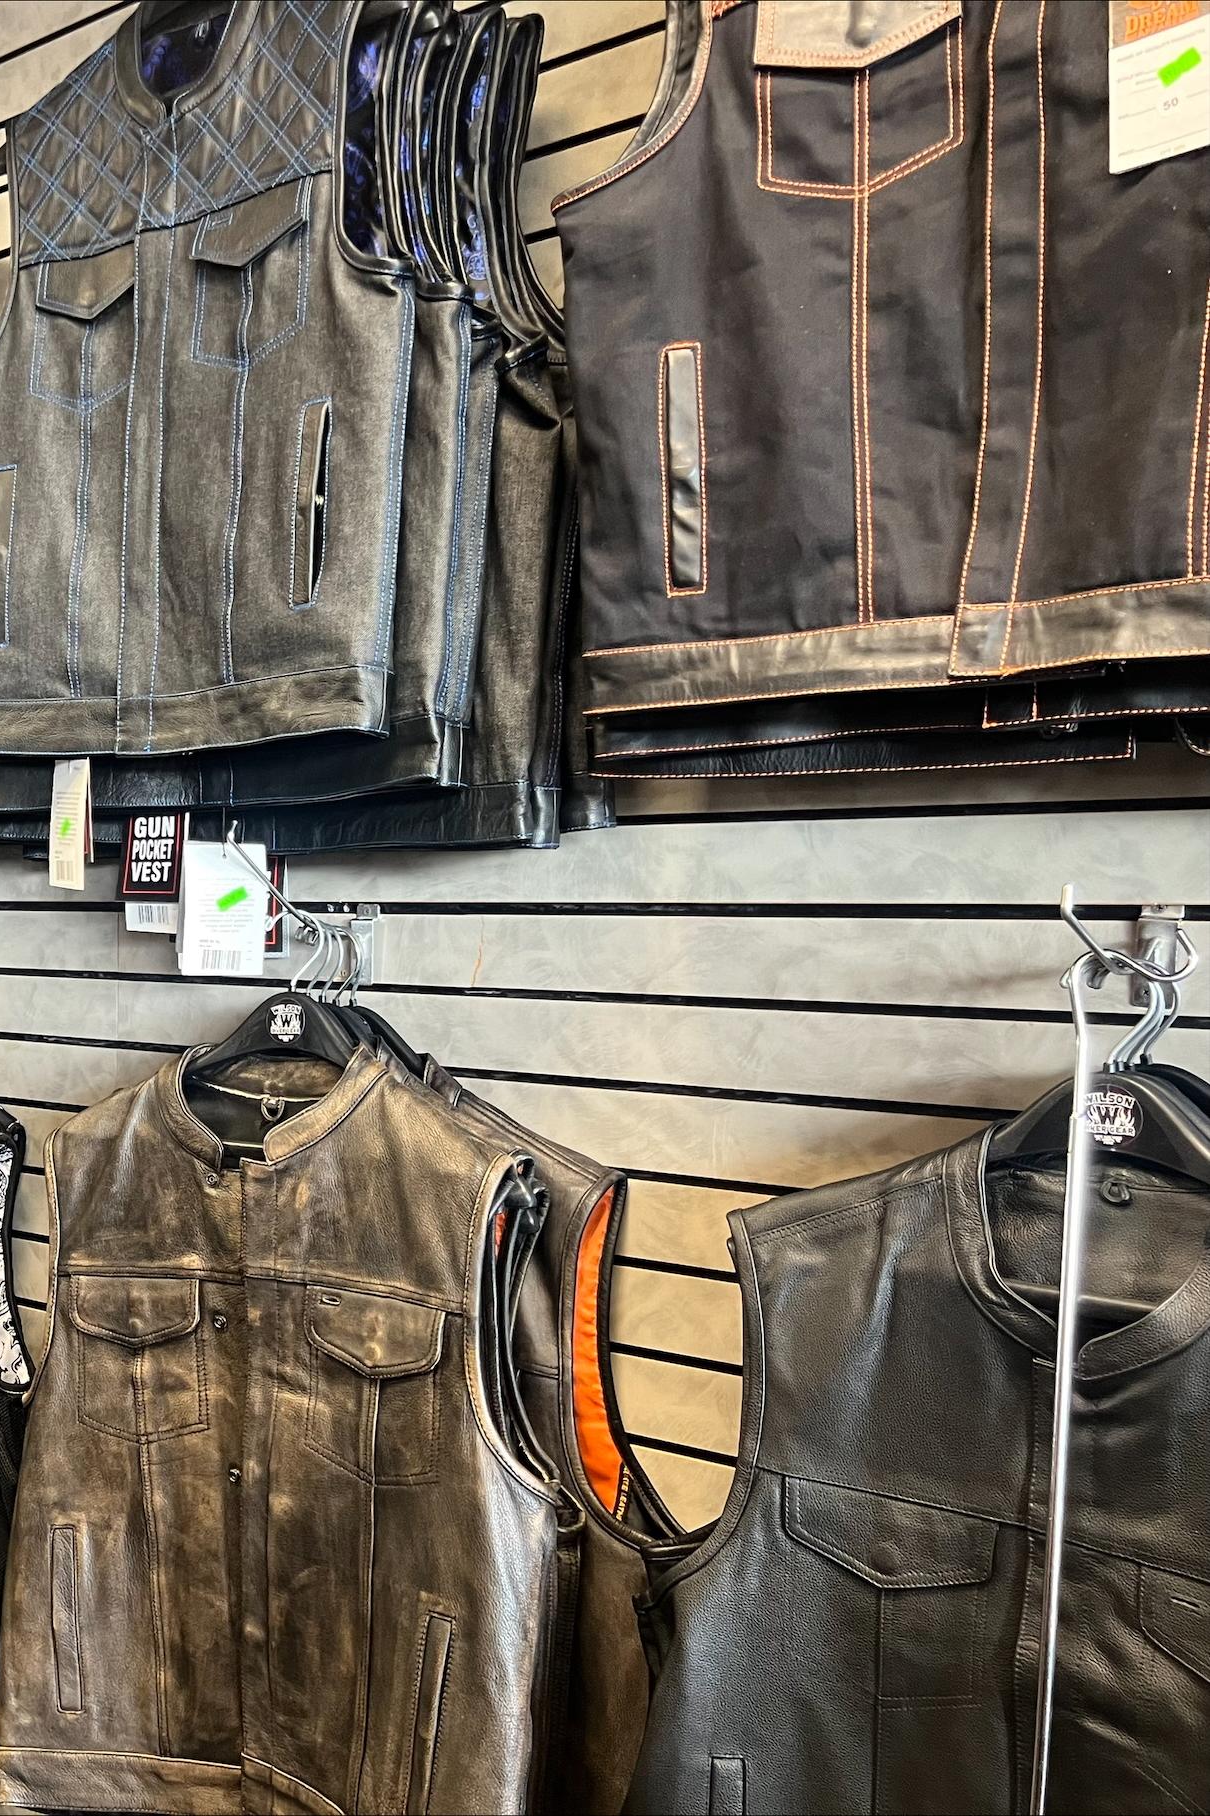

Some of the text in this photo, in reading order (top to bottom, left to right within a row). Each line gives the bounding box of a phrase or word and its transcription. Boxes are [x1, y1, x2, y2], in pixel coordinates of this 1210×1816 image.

[1163, 97, 1179, 111] 50
[134, 816, 175, 838] GUN
[132, 839, 174, 860] POCKET
[131, 862, 172, 882] VEST
[271, 1004, 300, 1014] WILSON
[1109, 1127, 1135, 1135] GEAR
